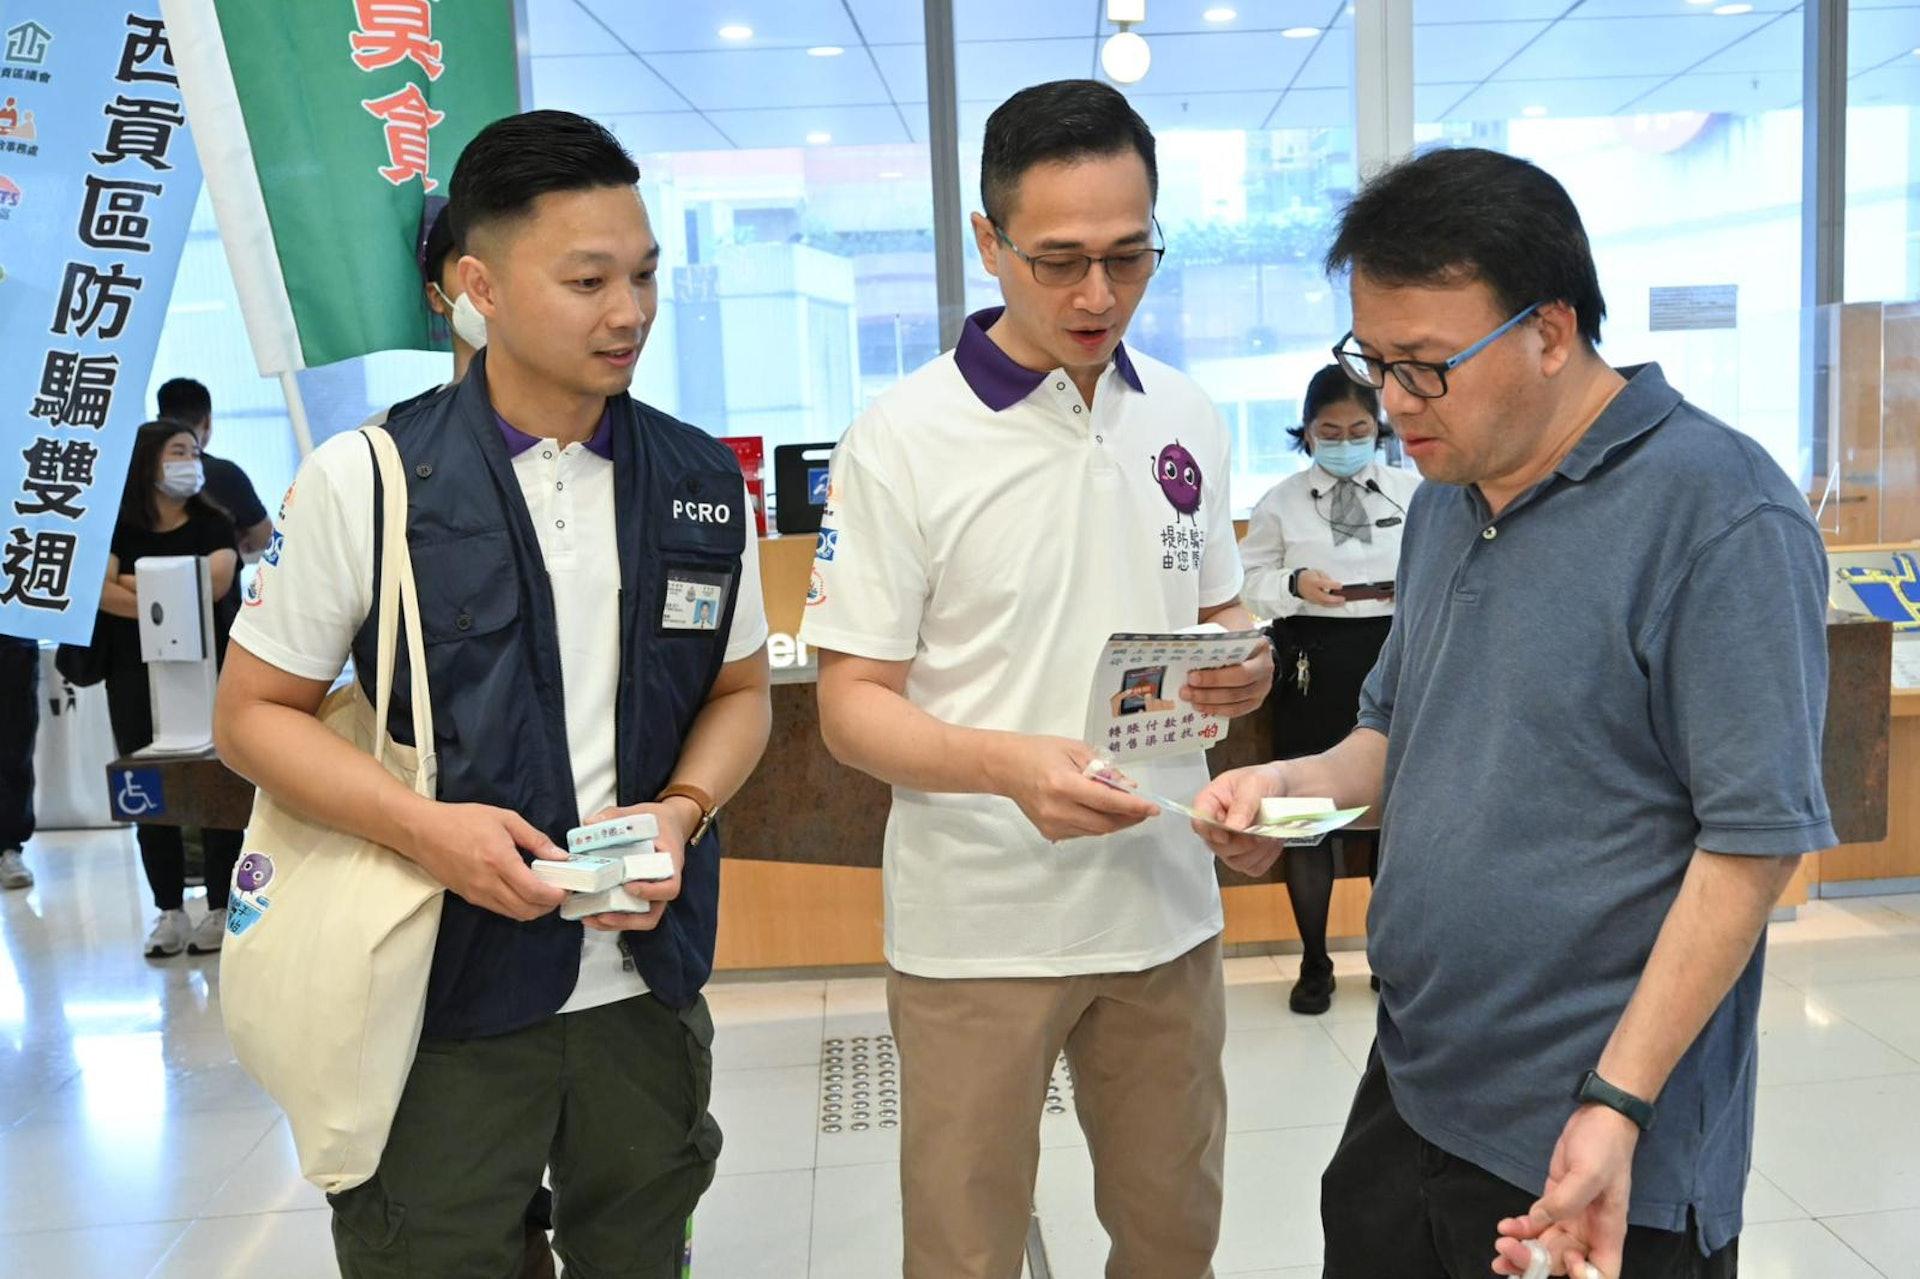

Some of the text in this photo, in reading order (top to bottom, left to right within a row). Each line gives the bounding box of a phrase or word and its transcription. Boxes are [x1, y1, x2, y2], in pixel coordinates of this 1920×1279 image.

[0, 13, 184, 612] 西貢區防騙雙週
[672, 499, 731, 524] PCRO
